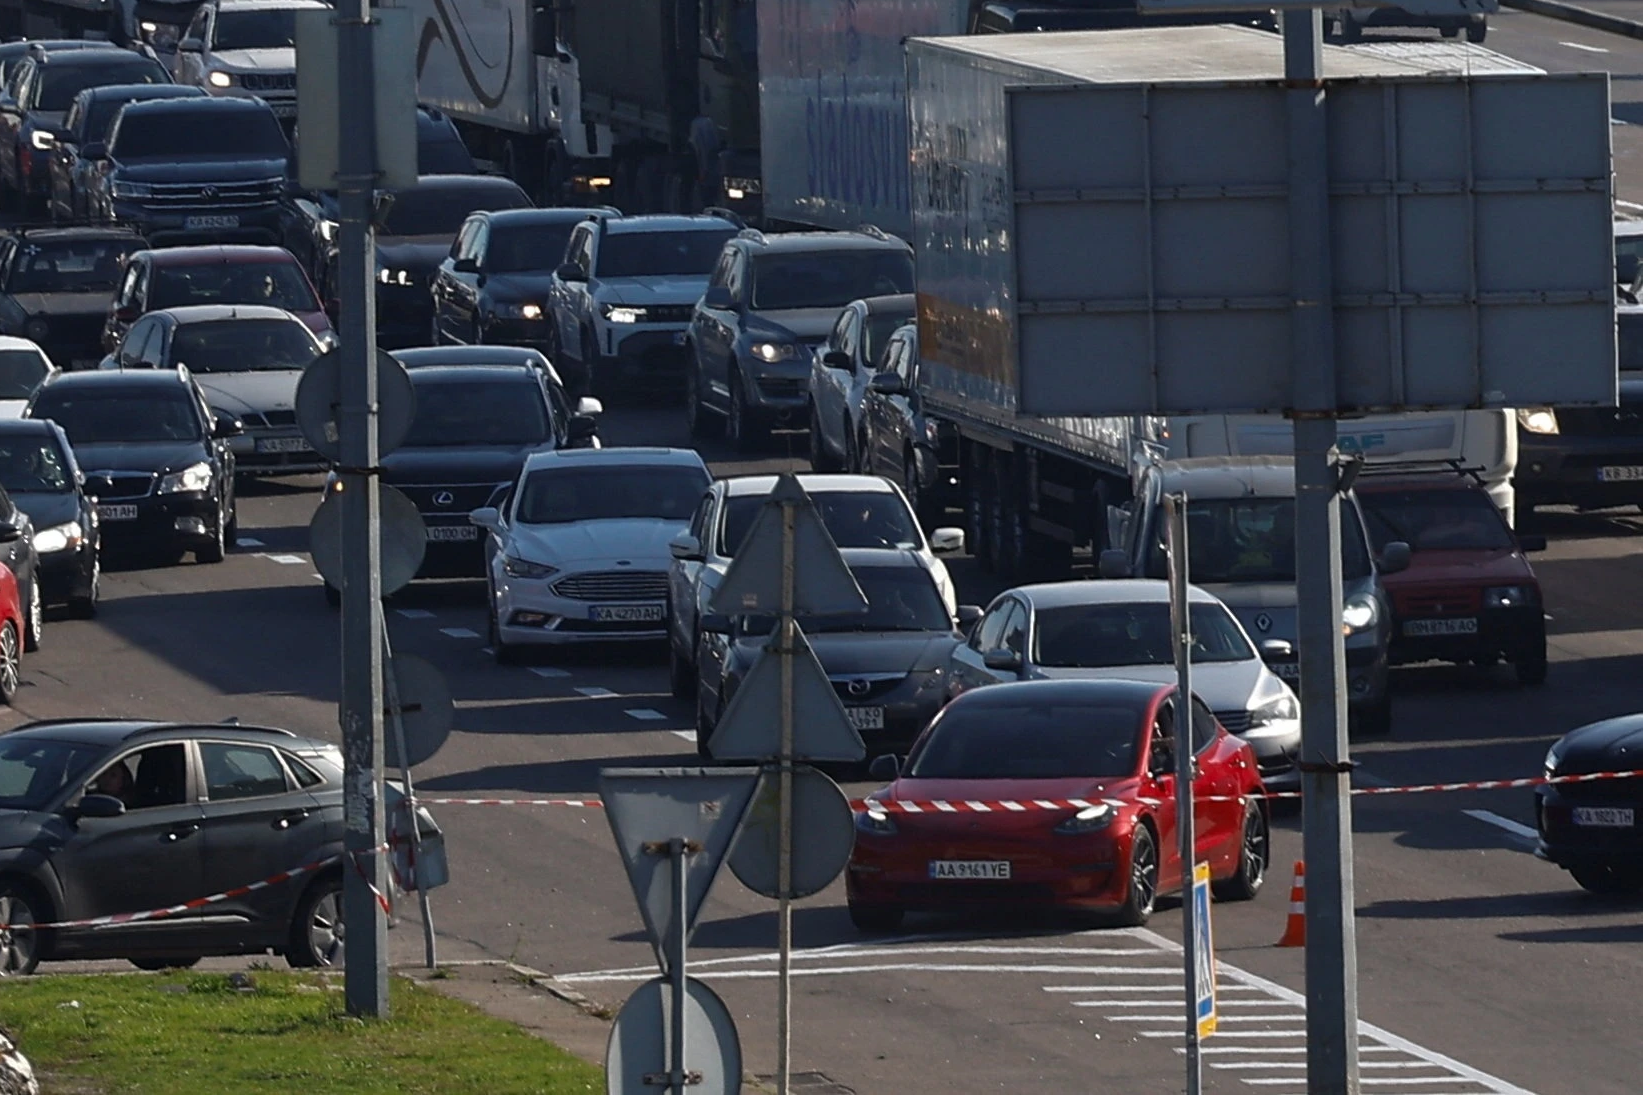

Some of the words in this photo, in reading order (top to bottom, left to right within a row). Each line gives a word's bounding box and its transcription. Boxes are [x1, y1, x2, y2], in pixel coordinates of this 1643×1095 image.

[1339, 433, 1386, 451] AF
[121, 506, 136, 517] AH
[597, 607, 613, 620] KA
[644, 607, 660, 619] AH
[938, 863, 957, 877] AA
[990, 863, 1008, 877] YE
